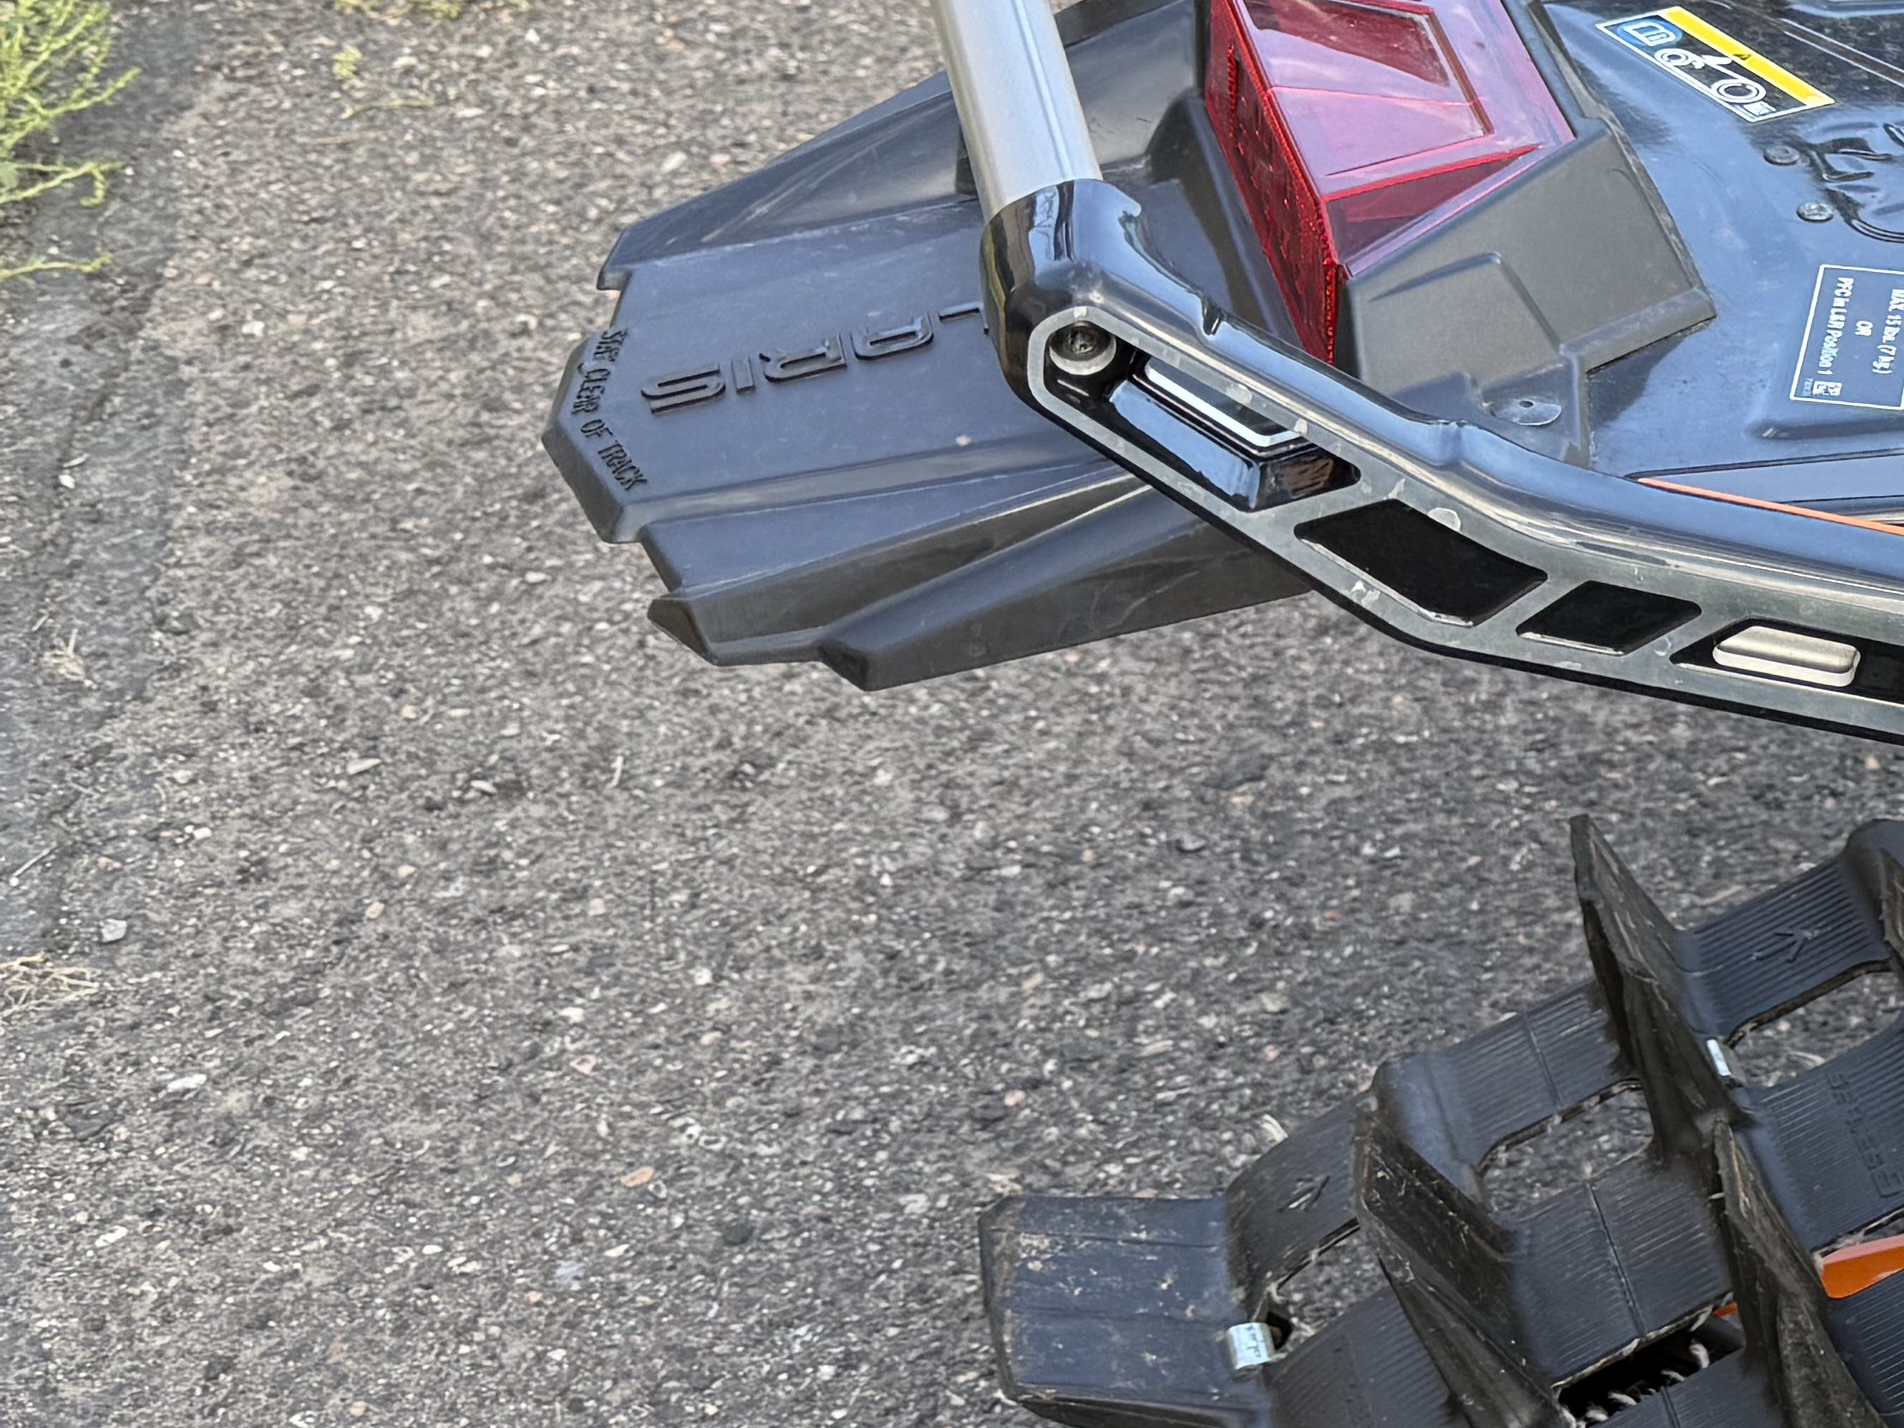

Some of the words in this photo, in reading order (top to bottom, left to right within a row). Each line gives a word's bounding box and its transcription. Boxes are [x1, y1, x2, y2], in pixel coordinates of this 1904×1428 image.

[1833, 277, 1854, 297] PFC
[1855, 320, 1873, 336] OR
[1885, 314, 1902, 325] 15
[593, 328, 628, 362] STAY
[1819, 329, 1843, 368] Position
[571, 368, 611, 414] CLEAR
[580, 419, 613, 438] OF
[597, 440, 648, 491] TRACK
